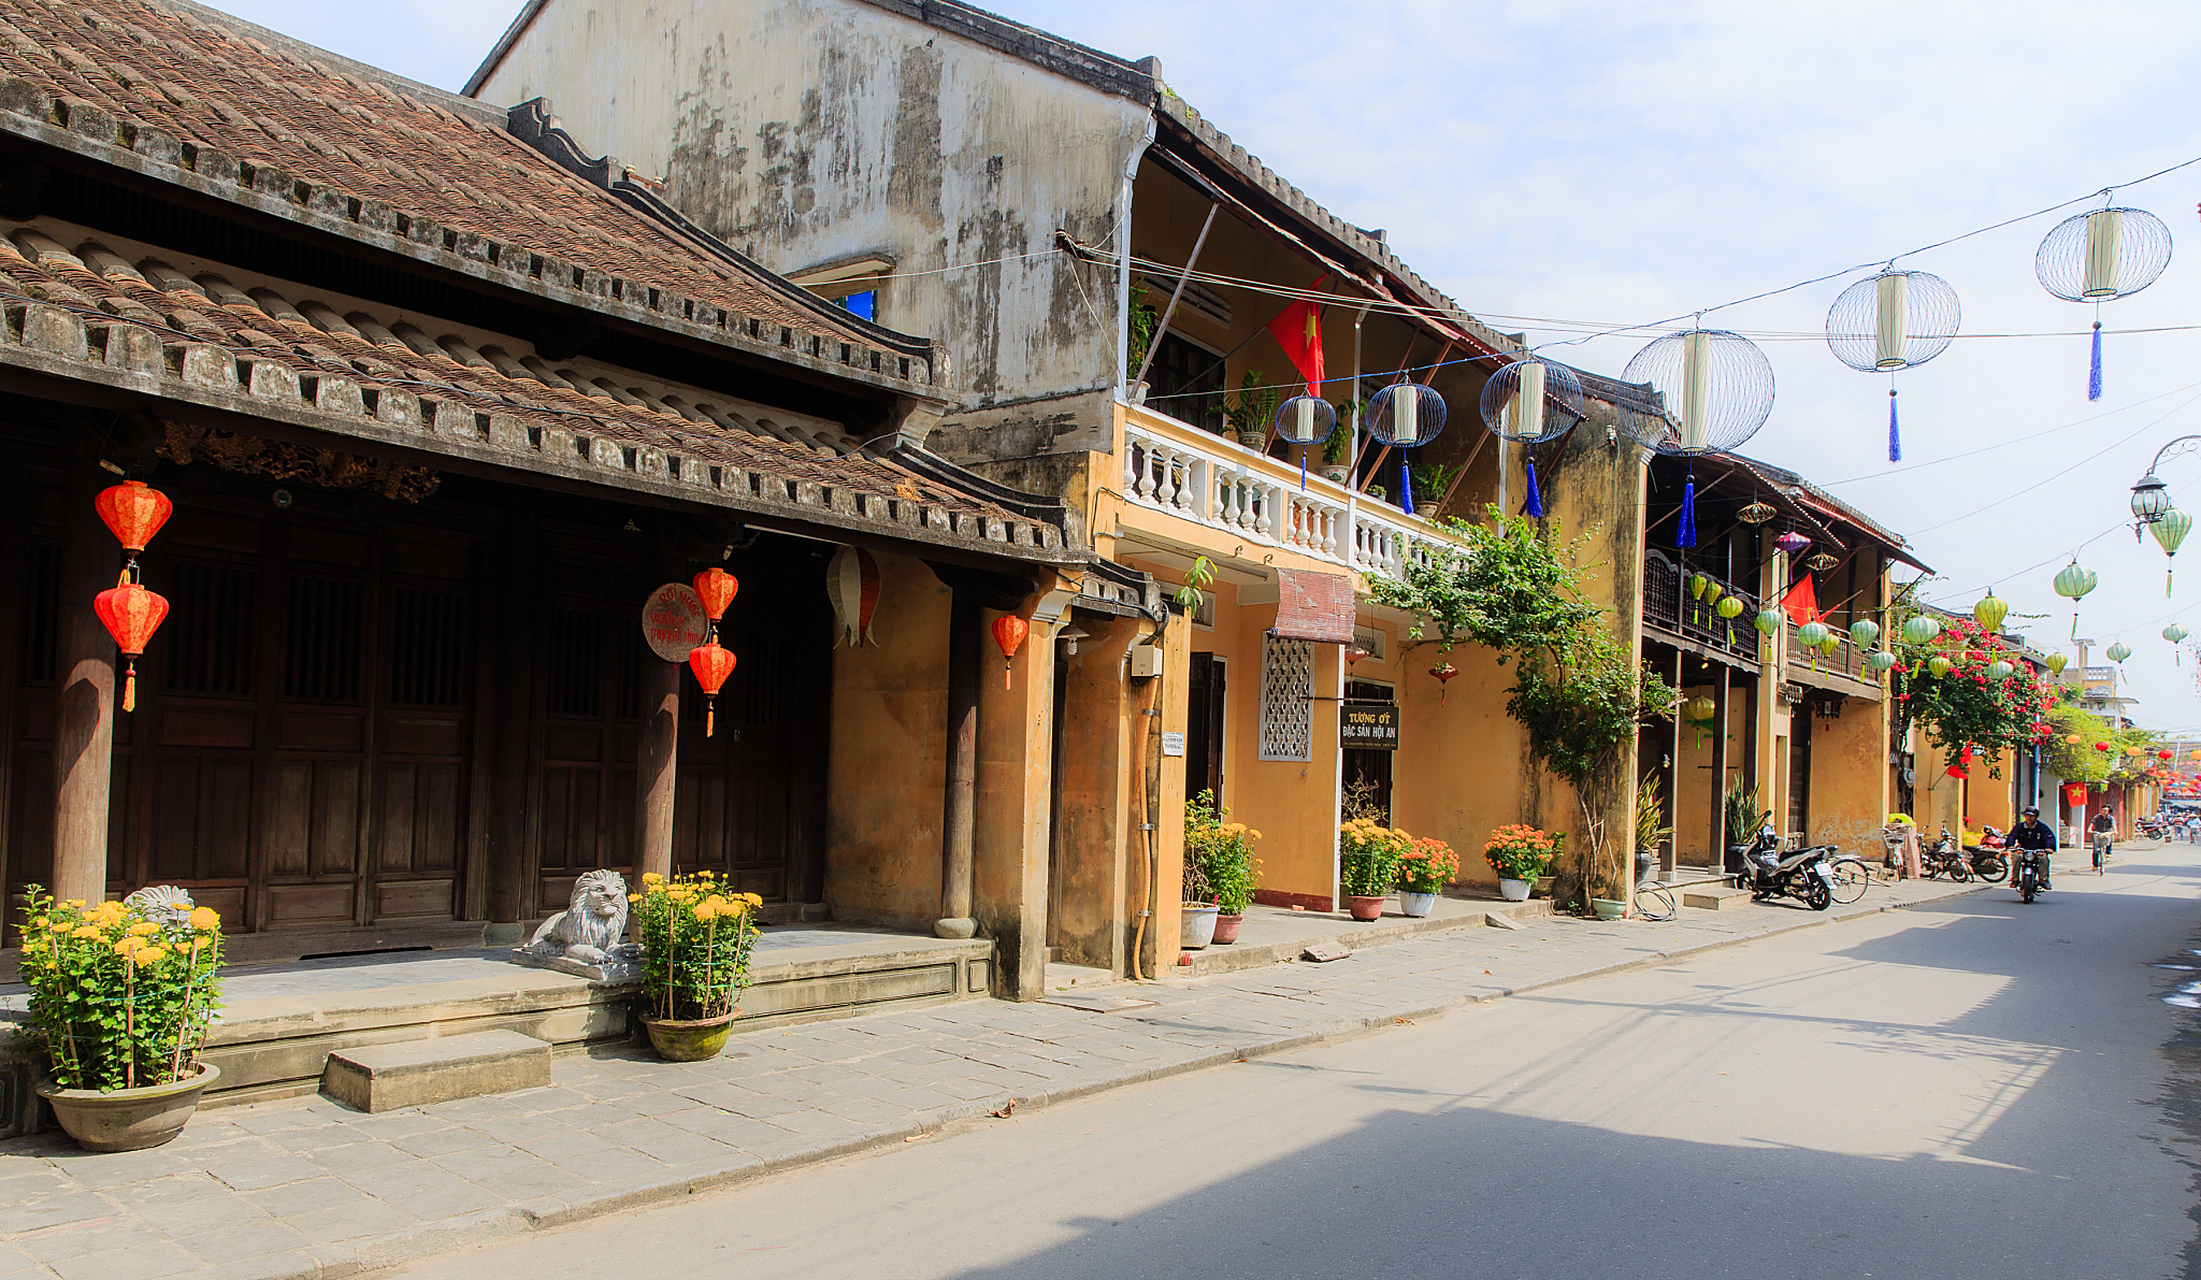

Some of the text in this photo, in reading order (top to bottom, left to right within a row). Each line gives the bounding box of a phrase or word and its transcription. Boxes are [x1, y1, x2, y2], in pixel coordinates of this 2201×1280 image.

[1343, 723, 1396, 740] ĐẶC SẢN HỘI AN
